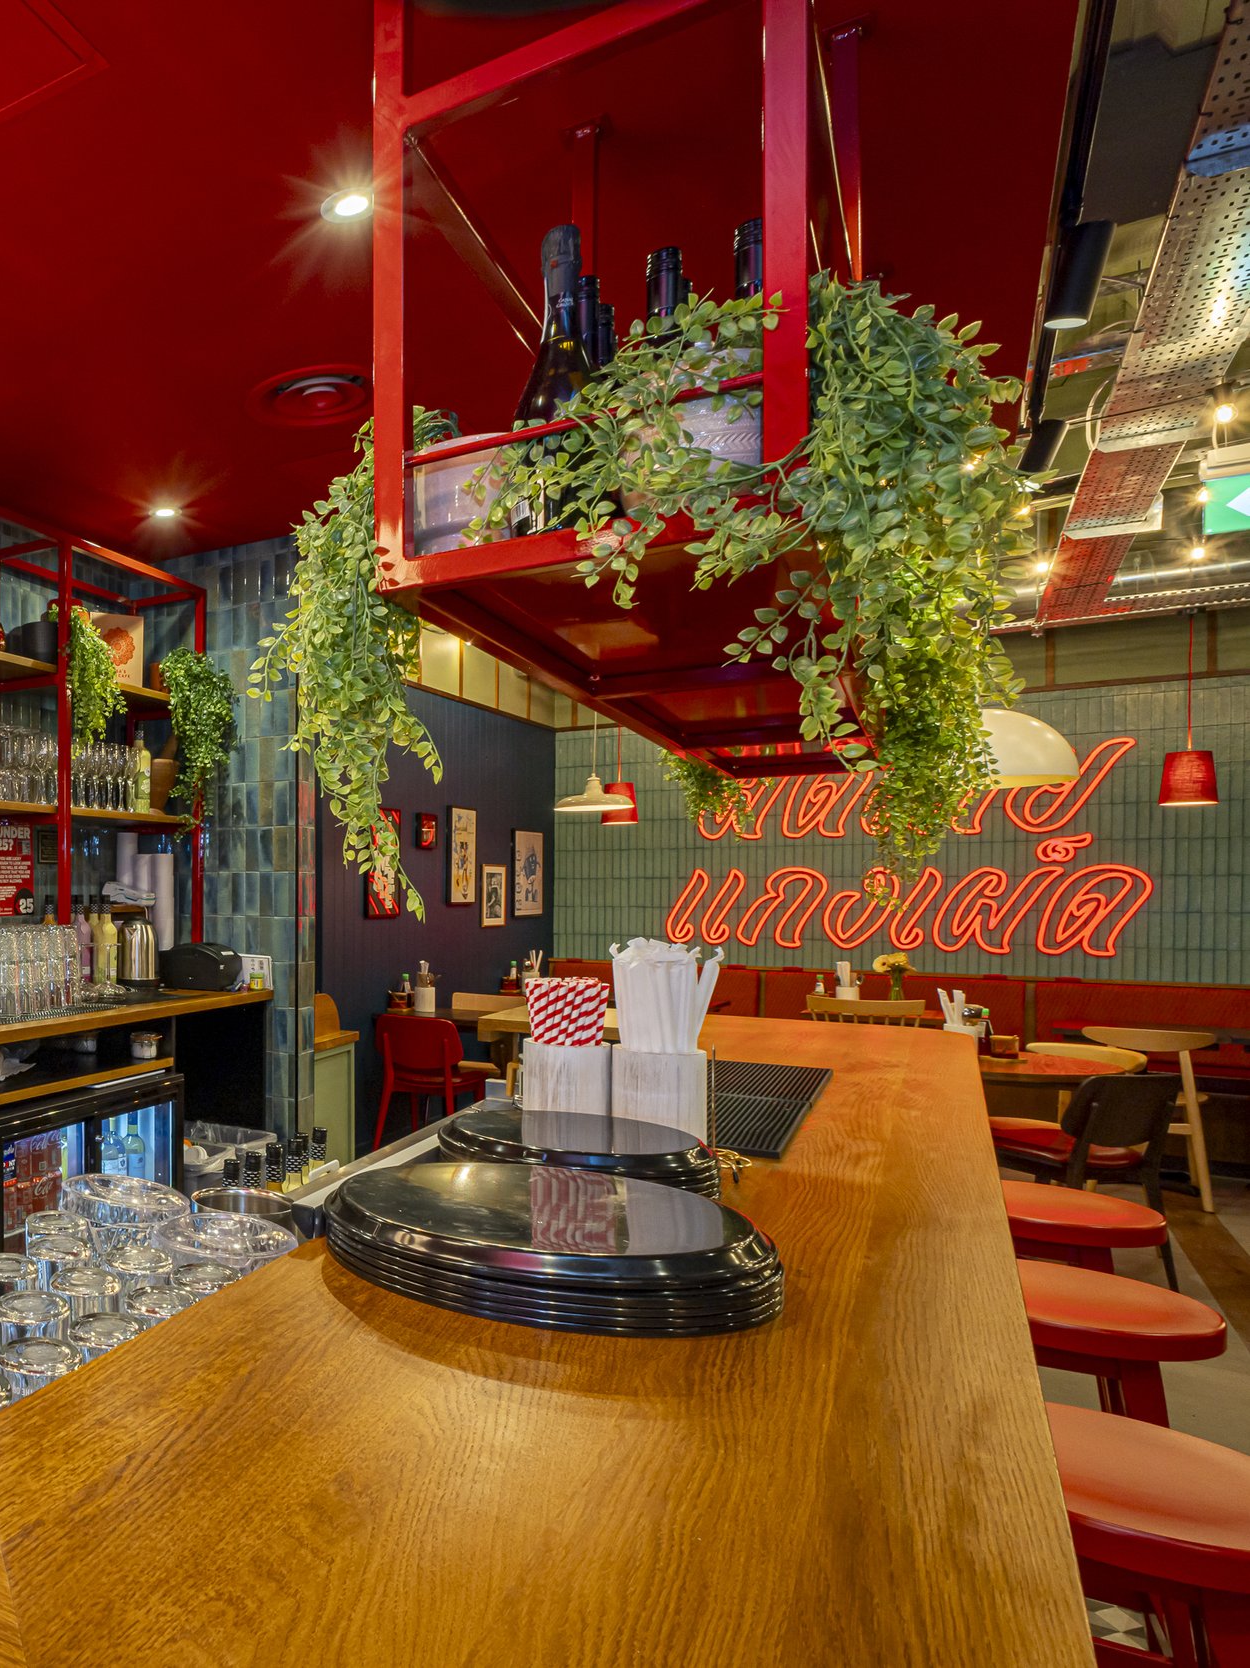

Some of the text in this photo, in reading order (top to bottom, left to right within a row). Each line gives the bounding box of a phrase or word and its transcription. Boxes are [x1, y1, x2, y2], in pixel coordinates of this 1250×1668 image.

[19, 898, 34, 914] 25
[666, 833, 1153, 957] แกงเผ็ด
